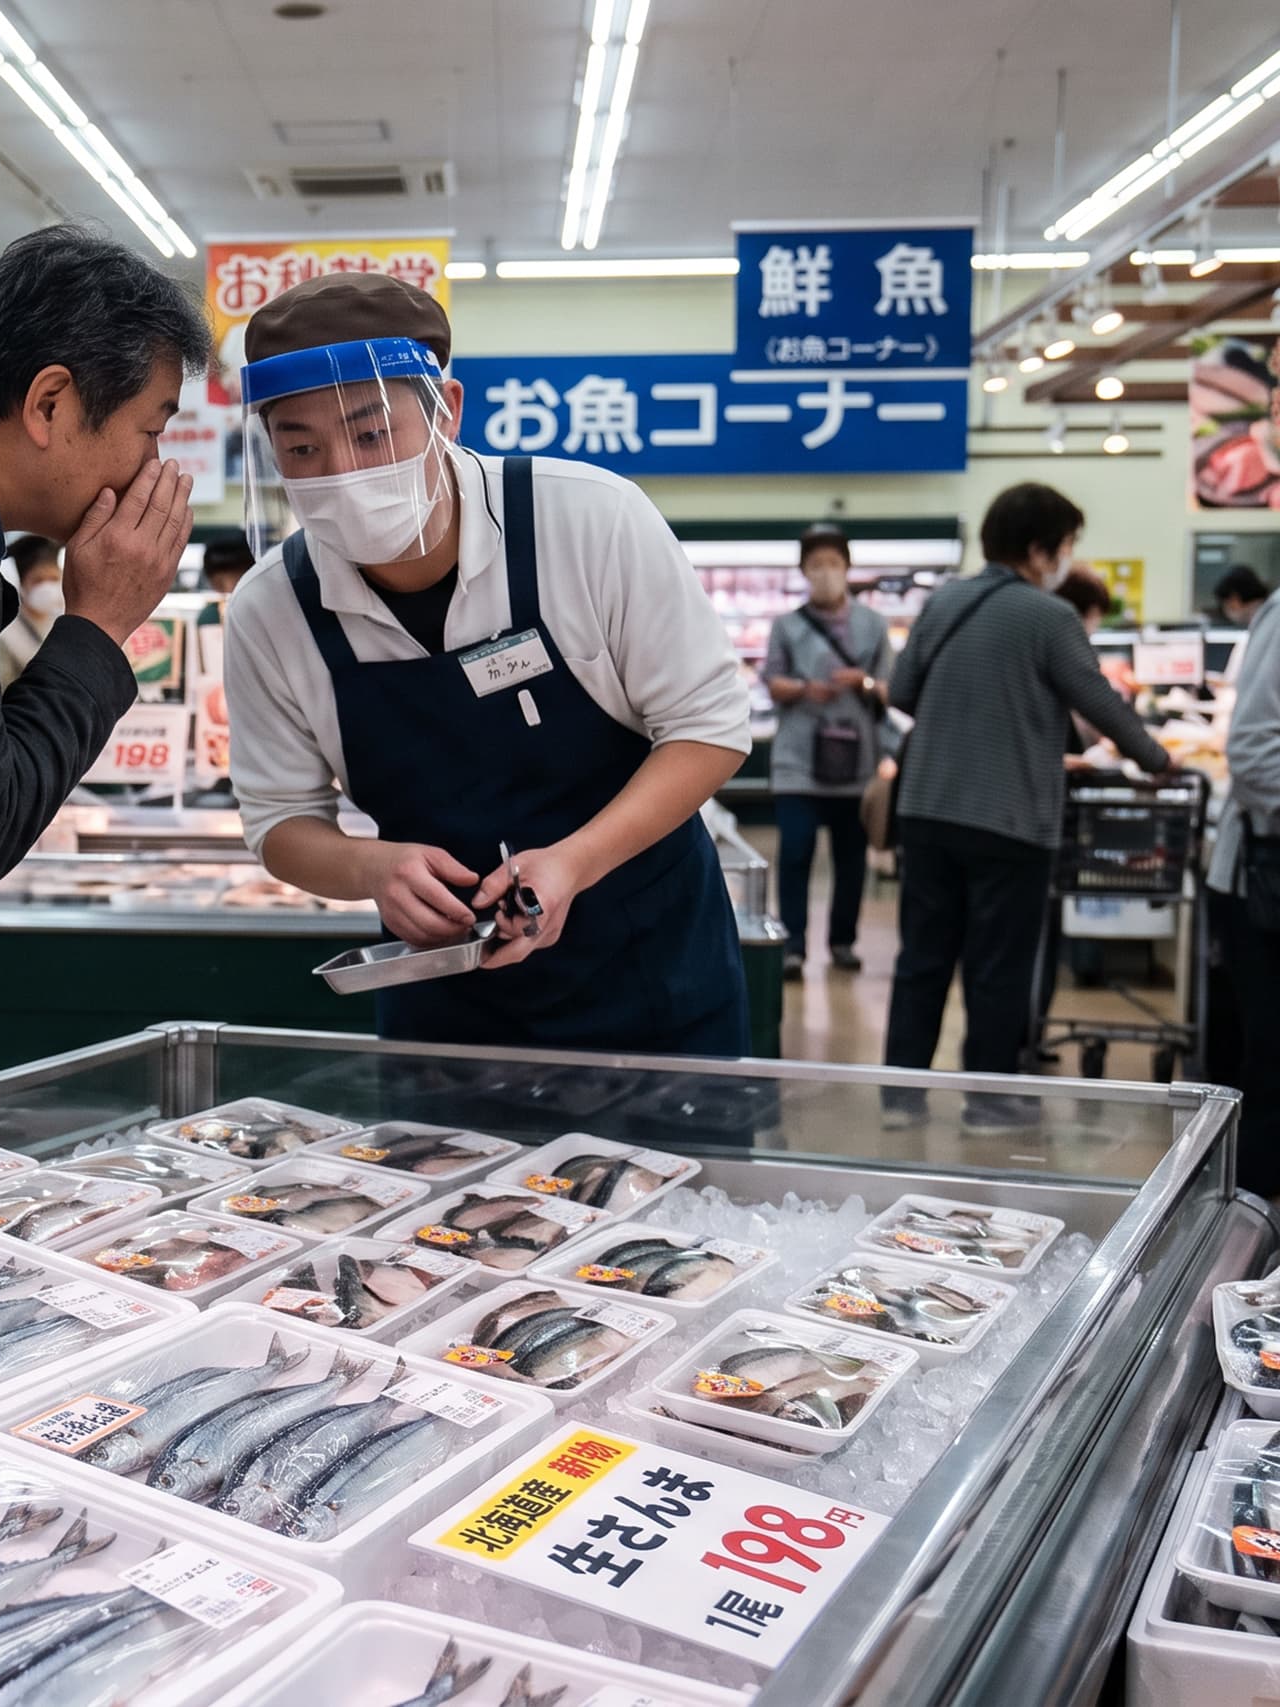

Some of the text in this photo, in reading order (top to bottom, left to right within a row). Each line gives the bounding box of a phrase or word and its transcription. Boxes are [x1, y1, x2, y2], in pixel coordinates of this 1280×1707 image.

[759, 242, 949, 319] 鮮魚
[484, 374, 947, 454] お魚コーナー
[113, 743, 170, 768] 198
[458, 1440, 622, 1553] 北海道産 新物
[547, 1466, 715, 1588] 生さんま
[704, 1590, 784, 1638] 1尾
